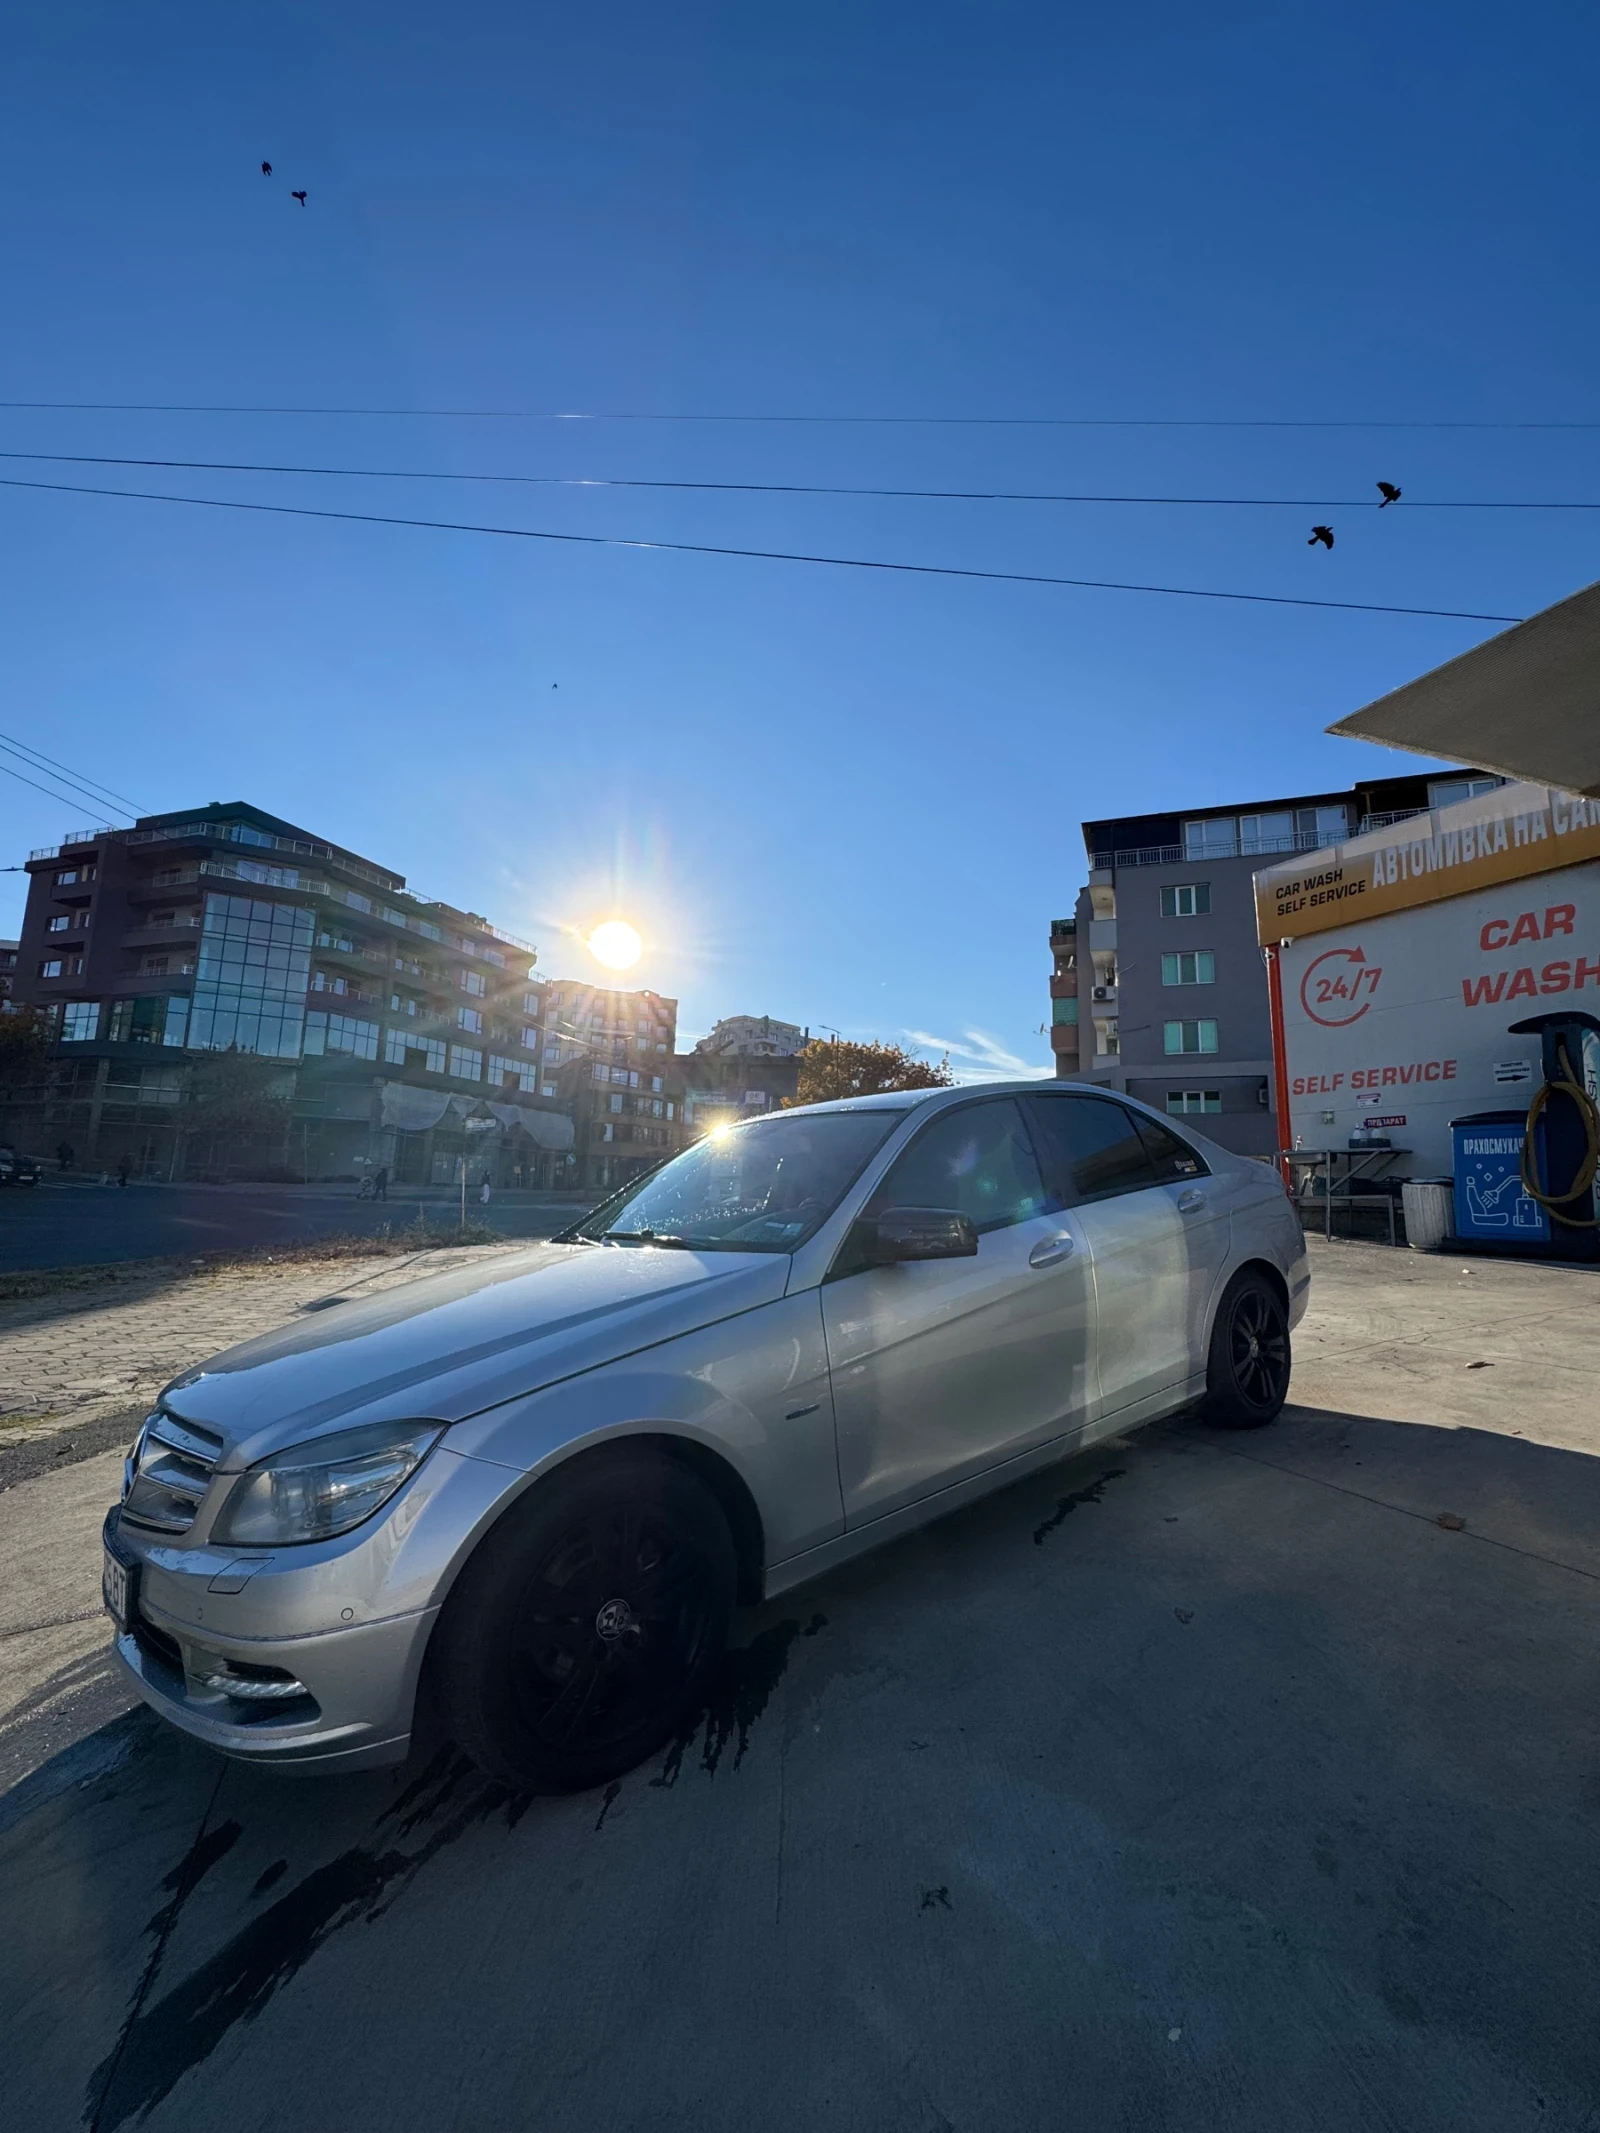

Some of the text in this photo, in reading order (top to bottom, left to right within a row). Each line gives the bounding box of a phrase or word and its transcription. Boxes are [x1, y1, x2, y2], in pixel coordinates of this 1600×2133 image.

[1372, 814, 1508, 888] АВТОМИВКА
[1513, 807, 1548, 847] НА
[1275, 868, 1343, 899] CAR WASH
[1276, 879, 1366, 916] SELF SERVICE
[1479, 903, 1576, 951] CAR
[1315, 967, 1382, 1003] 24/7
[1462, 955, 1600, 1007] WASH
[1292, 1059, 1458, 1096] SELF SERVICE
